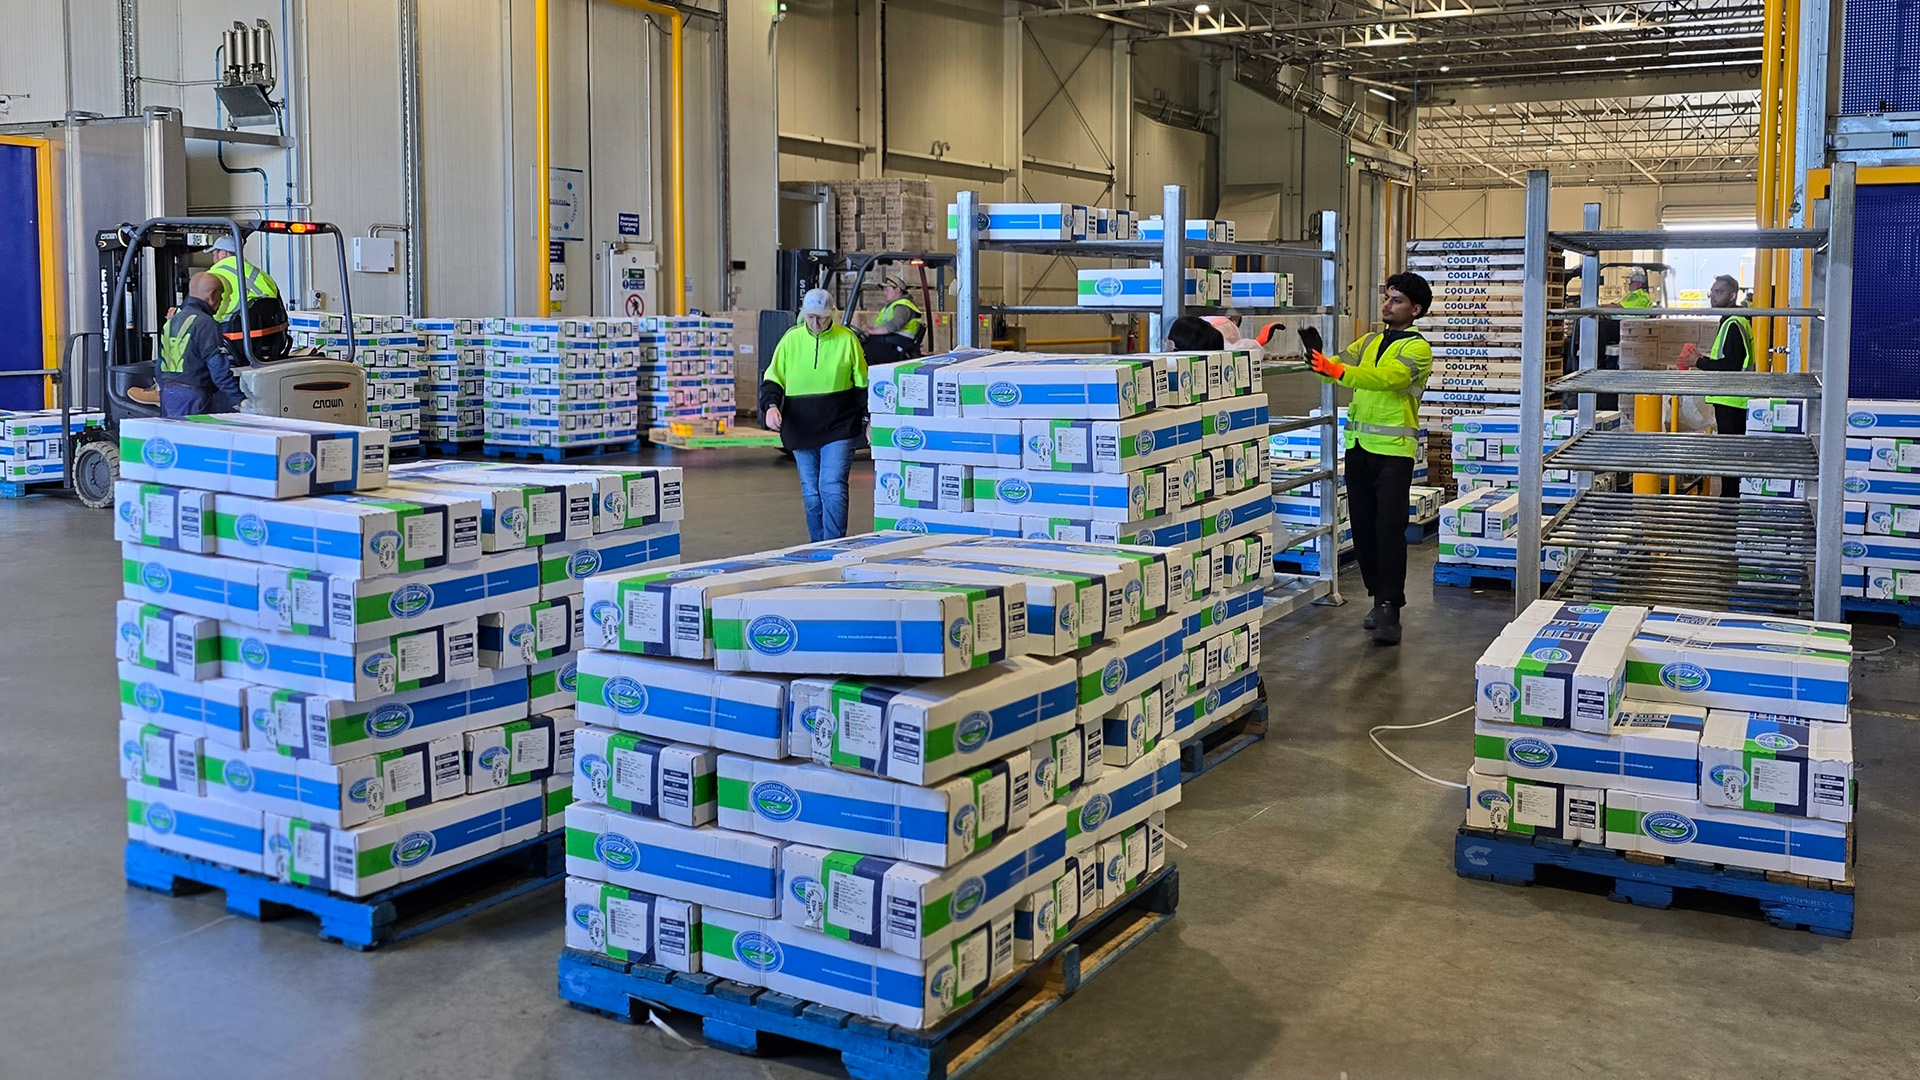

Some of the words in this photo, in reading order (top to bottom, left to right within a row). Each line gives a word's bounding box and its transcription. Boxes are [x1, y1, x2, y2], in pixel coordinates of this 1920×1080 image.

[1447, 256, 1490, 264] COOLPAK
[1444, 287, 1487, 295] COOLPAK
[1444, 302, 1487, 310] COOLPAK
[1447, 317, 1491, 325] COOLPAK
[1445, 348, 1488, 356] COOLPAK
[1445, 363, 1488, 371] COOLPAK
[1441, 378, 1484, 386] COOLPAK
[1443, 393, 1486, 401] COOLPAK
